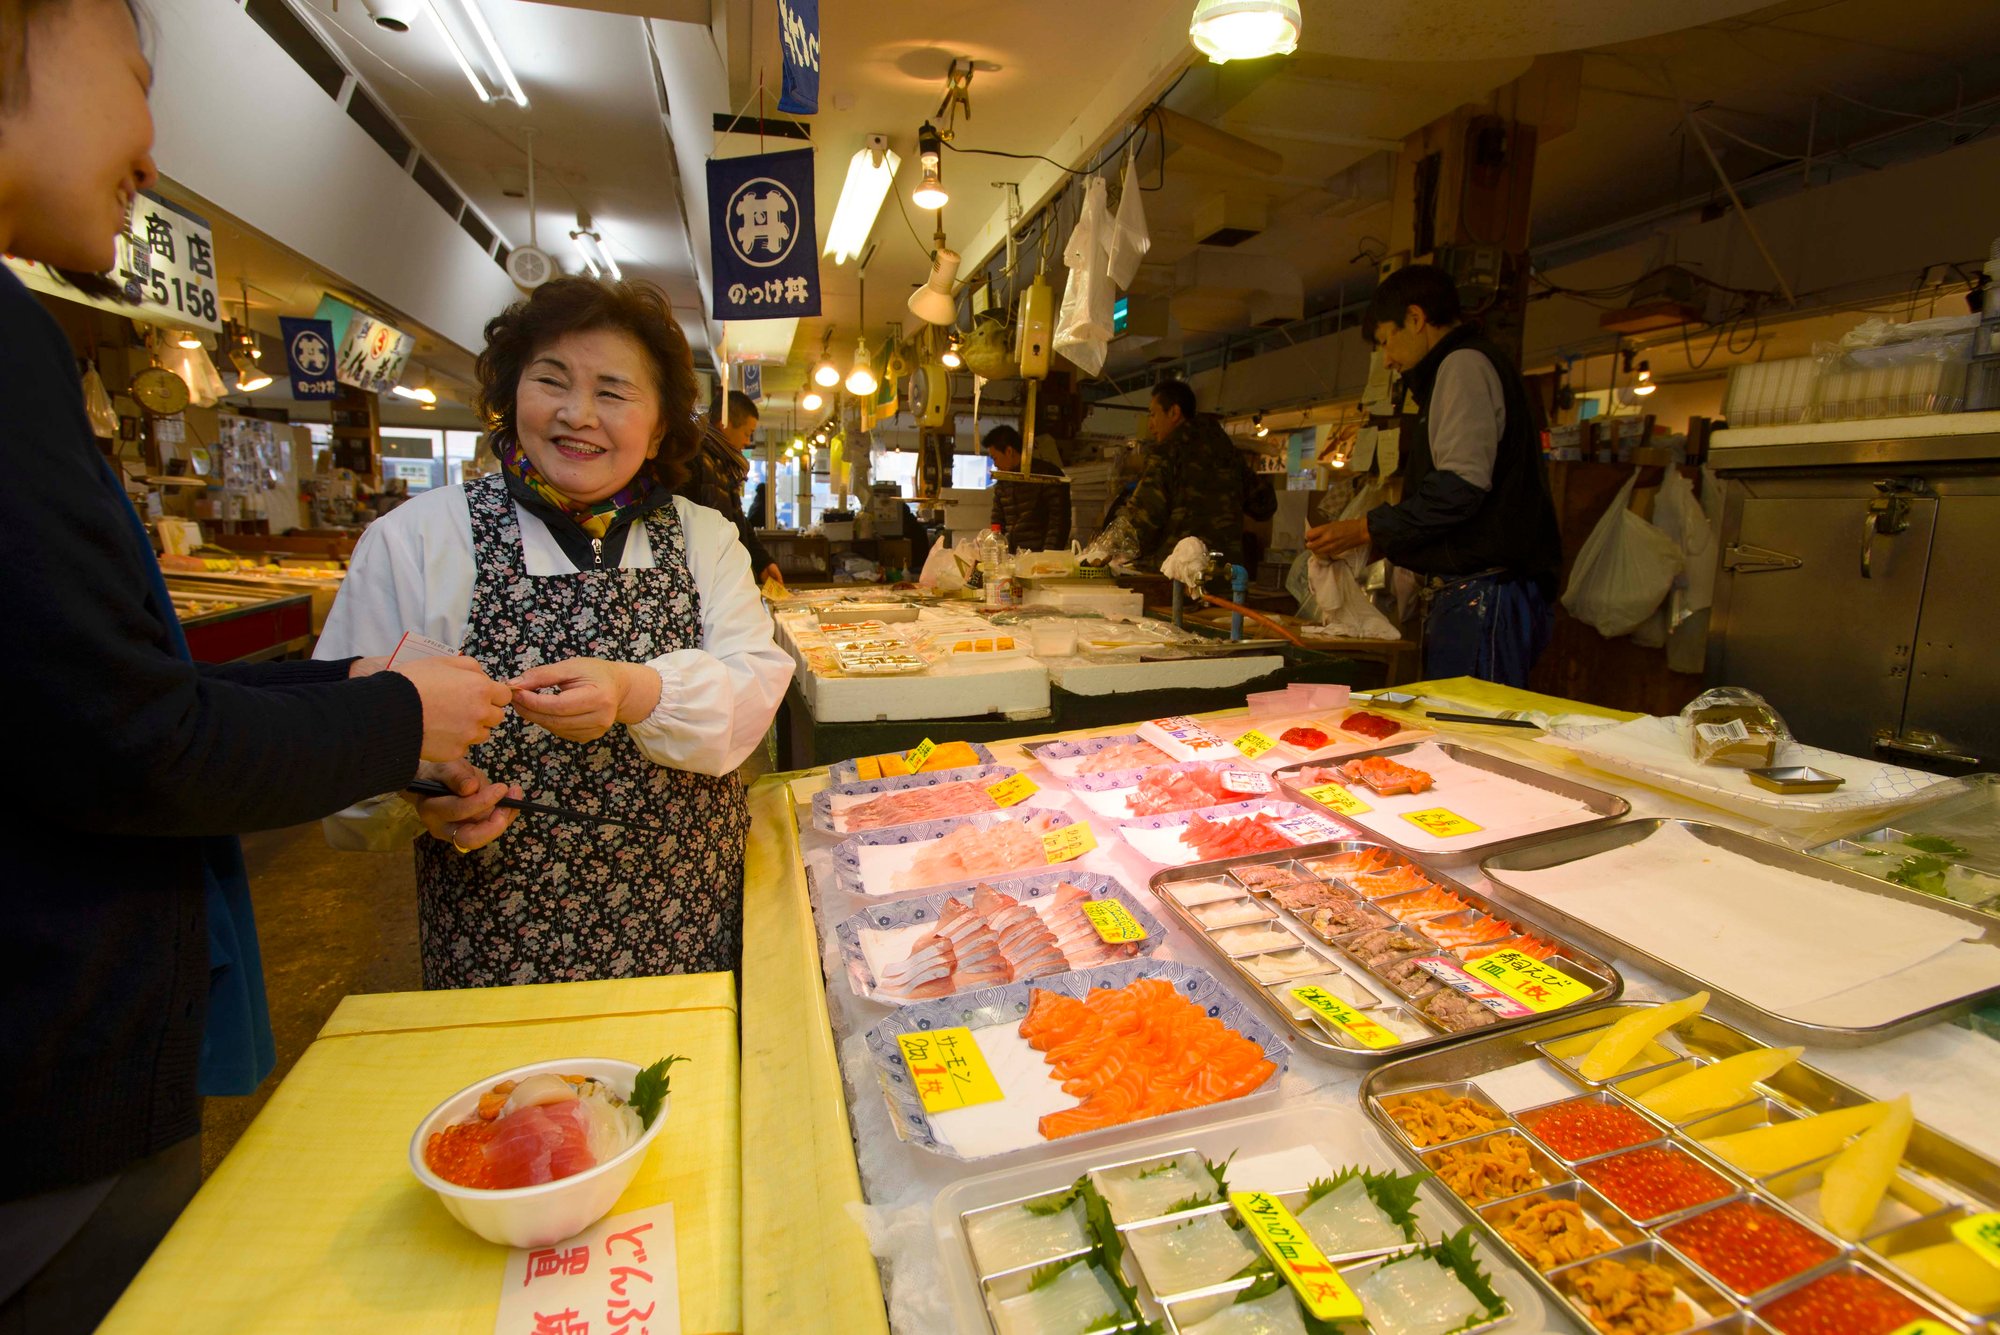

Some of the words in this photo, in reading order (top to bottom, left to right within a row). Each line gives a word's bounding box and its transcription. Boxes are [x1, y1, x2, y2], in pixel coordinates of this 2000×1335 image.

[145, 211, 214, 279] 商店
[728, 276, 808, 304] のっけ丼
[1479, 961, 1506, 979] 1皿
[1516, 980, 1551, 1003] 1枚
[1498, 952, 1571, 988] 寿司えび
[937, 1036, 972, 1083] サーモン
